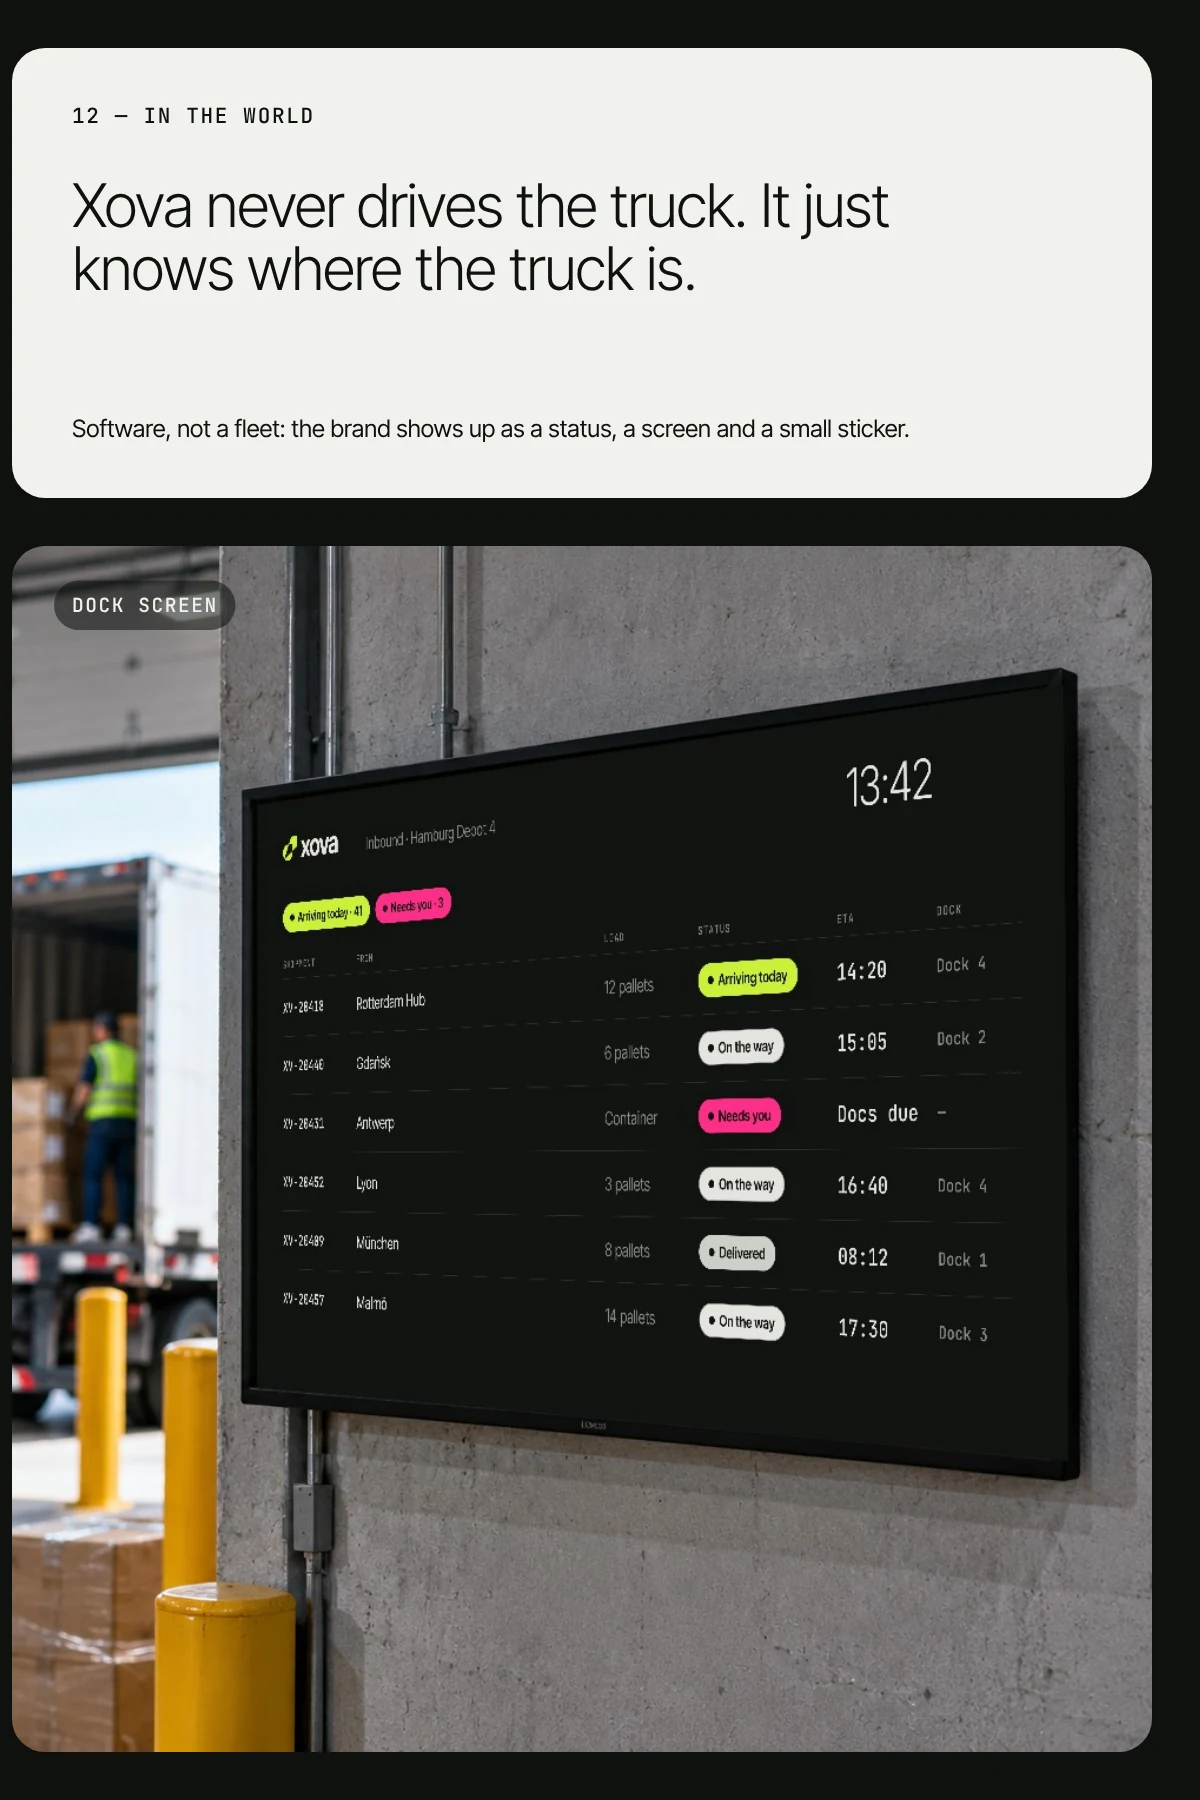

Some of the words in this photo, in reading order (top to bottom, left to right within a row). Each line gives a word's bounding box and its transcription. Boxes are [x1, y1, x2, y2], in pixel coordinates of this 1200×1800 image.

[846, 757, 933, 808] 13:42
[365, 831, 404, 850] Inbound
[410, 828, 455, 845] Hamburg
[488, 819, 496, 834] 4
[299, 834, 340, 858] xova
[297, 909, 327, 923] Arriving
[326, 907, 349, 921] today
[353, 905, 364, 917] 41
[390, 900, 416, 914] Needs
[416, 901, 433, 913] you
[437, 896, 445, 909] 3
[936, 904, 962, 917] DOCK
[836, 912, 854, 924] ETA
[697, 923, 731, 936] STATUS
[836, 959, 887, 982] 14:20
[936, 956, 970, 974] Dock
[978, 955, 986, 970] 4
[603, 979, 616, 995] 12
[618, 977, 655, 998] pallets
[717, 971, 758, 988] Arriving
[758, 969, 788, 985] today
[356, 993, 404, 1011] Rotterdam
[405, 992, 427, 1008] Hub
[837, 1031, 887, 1053] 15:05
[936, 1030, 971, 1047] Dock
[978, 1029, 987, 1045] 2
[603, 1044, 613, 1061] 6
[614, 1044, 650, 1064] pallets
[717, 1040, 733, 1055] On
[734, 1040, 753, 1055] the
[753, 1041, 775, 1057] way
[604, 1110, 659, 1127] Container
[717, 1109, 751, 1123] Needs
[752, 1111, 772, 1125] you
[837, 1104, 878, 1123] Docs
[887, 1103, 919, 1123] due
[355, 1115, 396, 1133] Antwerp
[356, 1175, 378, 1194] Lyon
[604, 1176, 613, 1192] 3
[615, 1176, 652, 1196] pallets
[718, 1177, 734, 1191] On
[734, 1177, 753, 1191] the
[753, 1180, 775, 1194] way
[837, 1175, 888, 1195] 16:40
[938, 1177, 971, 1194] Dock
[979, 1177, 987, 1194] 4
[356, 1235, 400, 1251] München
[604, 1241, 613, 1258] 8
[614, 1242, 651, 1261] pallets
[719, 1246, 766, 1261] Delivered
[837, 1246, 888, 1267] 08:12
[938, 1251, 971, 1268] Dock
[979, 1252, 988, 1268] 1
[356, 1295, 388, 1311] Malmö
[604, 1307, 617, 1323] 14
[620, 1308, 656, 1328] pallets
[718, 1314, 734, 1329] On
[735, 1315, 753, 1330] the
[753, 1318, 776, 1333] way
[839, 1317, 888, 1340] 17:30
[939, 1324, 972, 1342] Dock
[979, 1327, 988, 1342] 3
